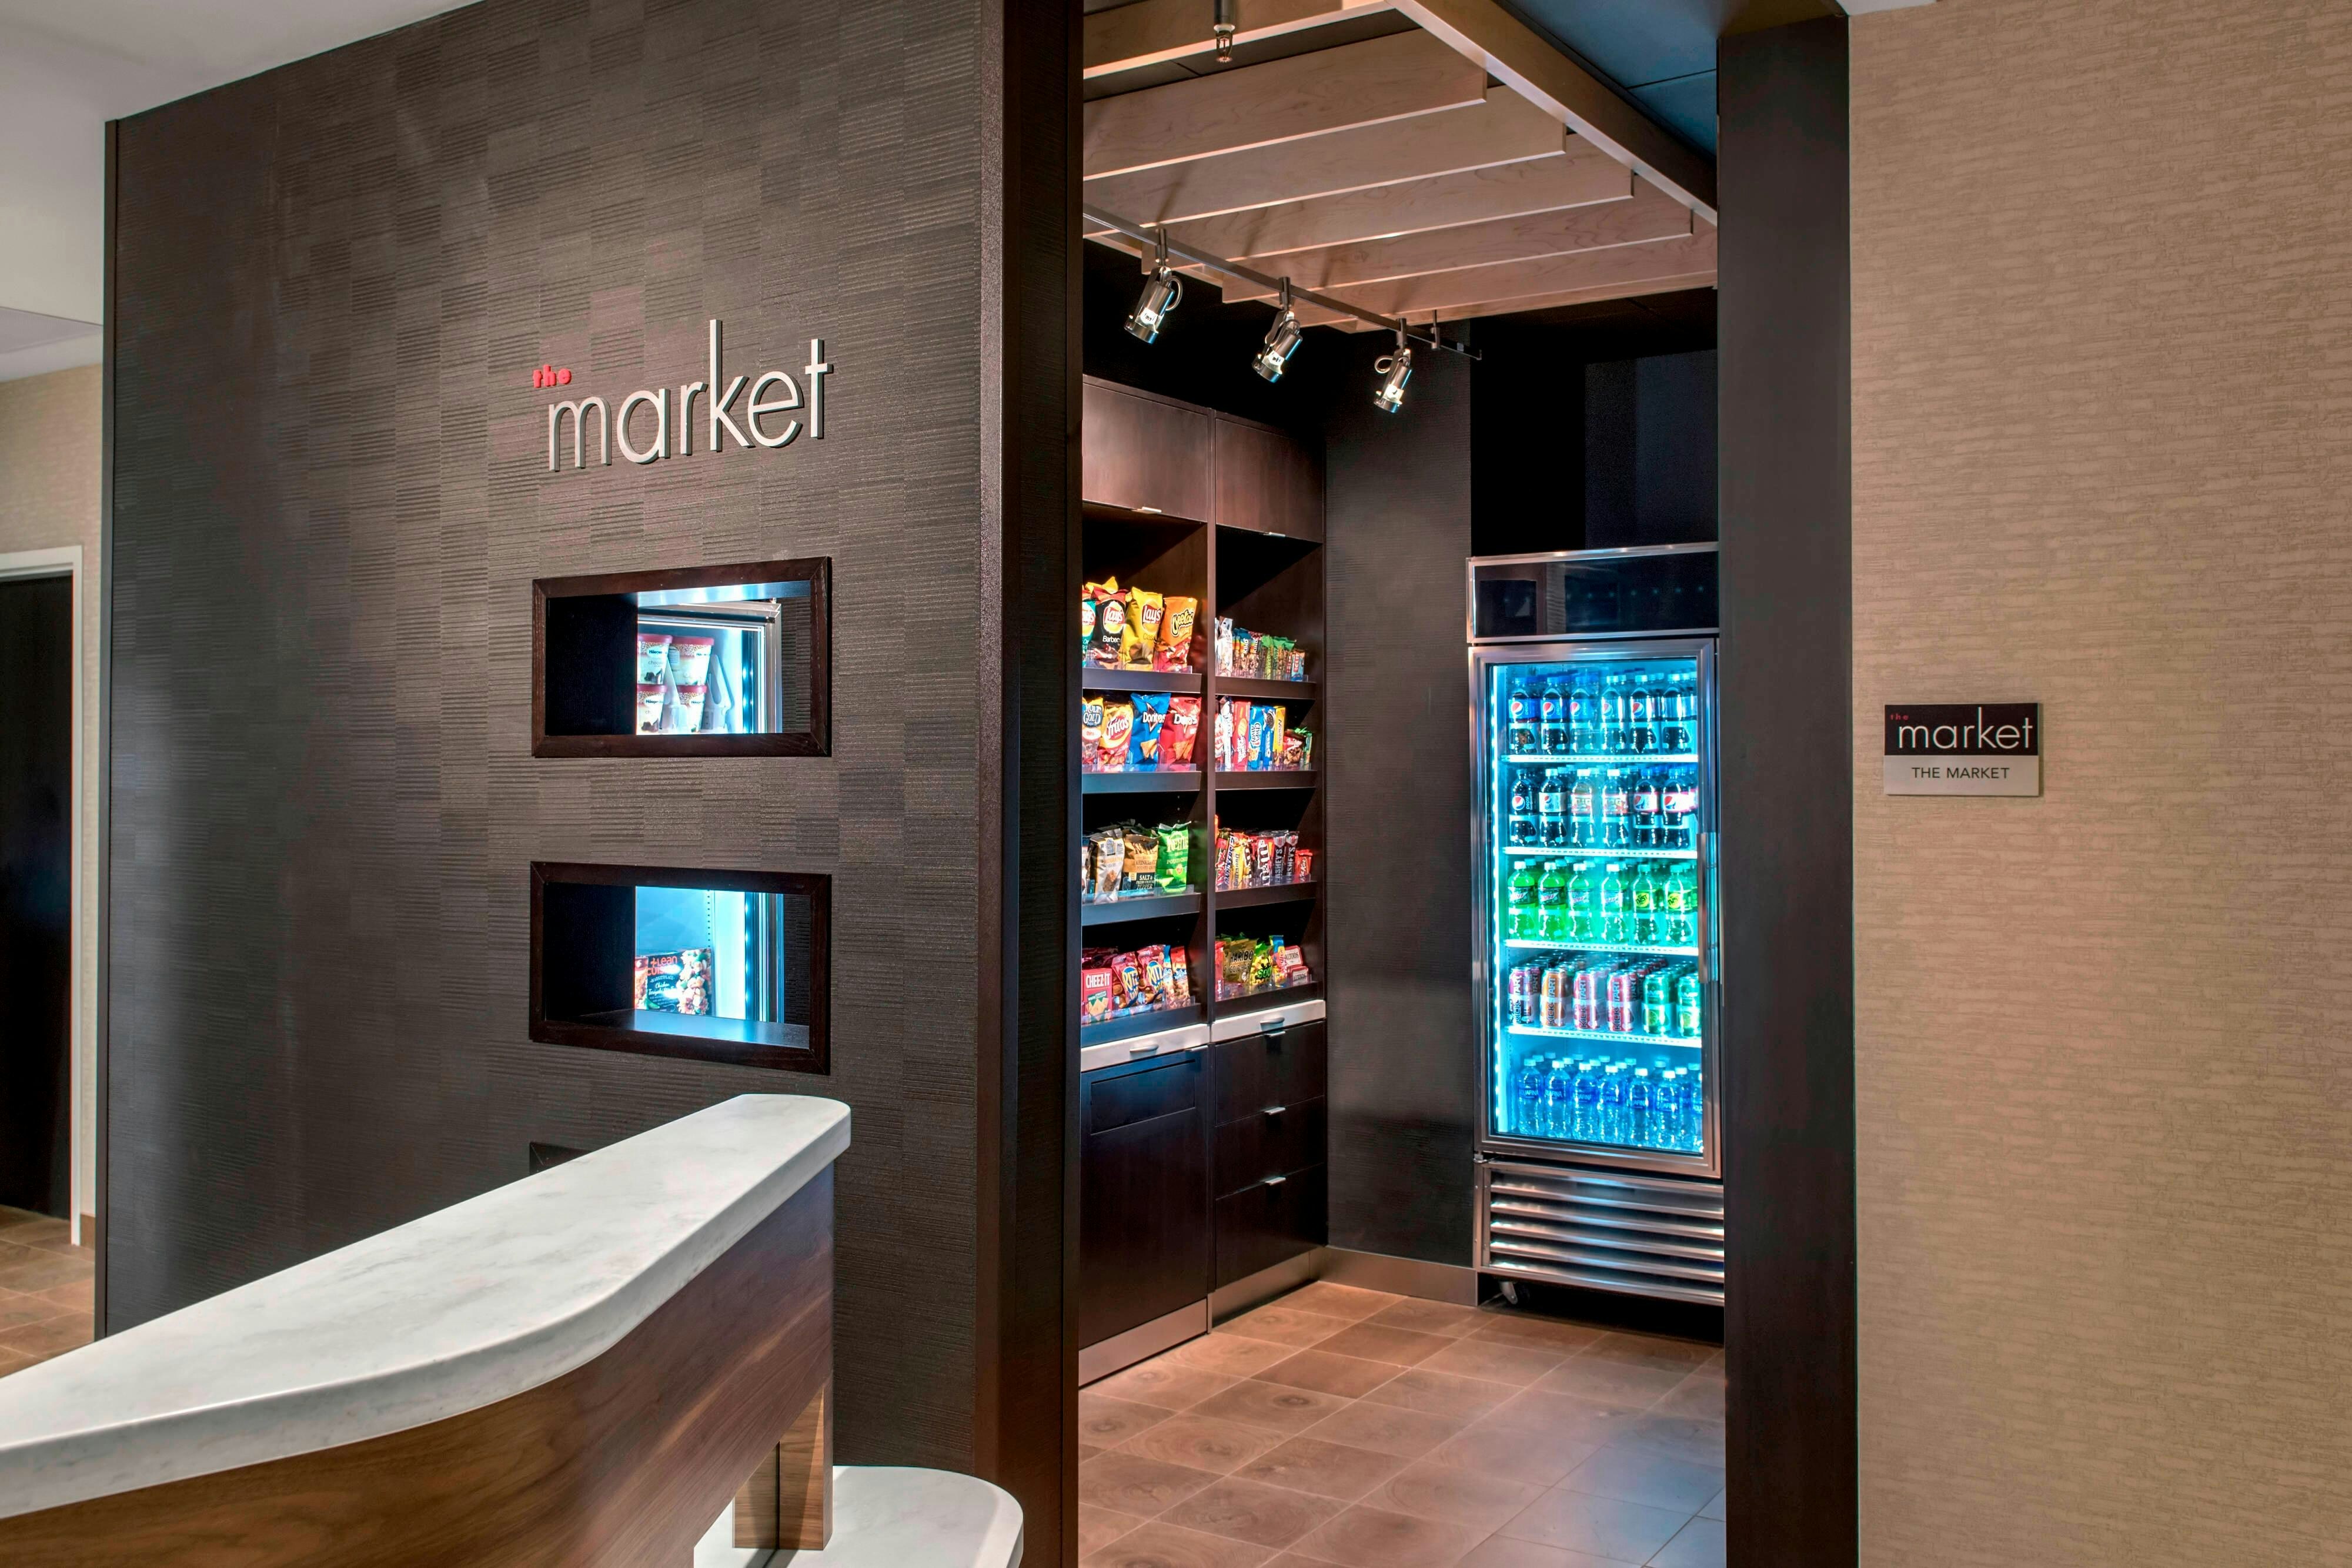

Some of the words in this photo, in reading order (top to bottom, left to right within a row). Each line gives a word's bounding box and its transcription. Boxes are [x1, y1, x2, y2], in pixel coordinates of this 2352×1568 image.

[533, 365, 572, 388] the
[549, 319, 834, 472] market
[1142, 605, 1161, 624] Lay's
[1083, 712, 1101, 724] GOLD
[1899, 707, 2033, 748] market
[1912, 767, 1940, 778] THE
[1946, 767, 2009, 778] MARKET
[1231, 950, 1254, 961] HARIBO
[1257, 966, 1272, 978] SOU
[1547, 977, 1556, 1026] KICKSTART
[1579, 979, 1587, 1028] KICKSTART
